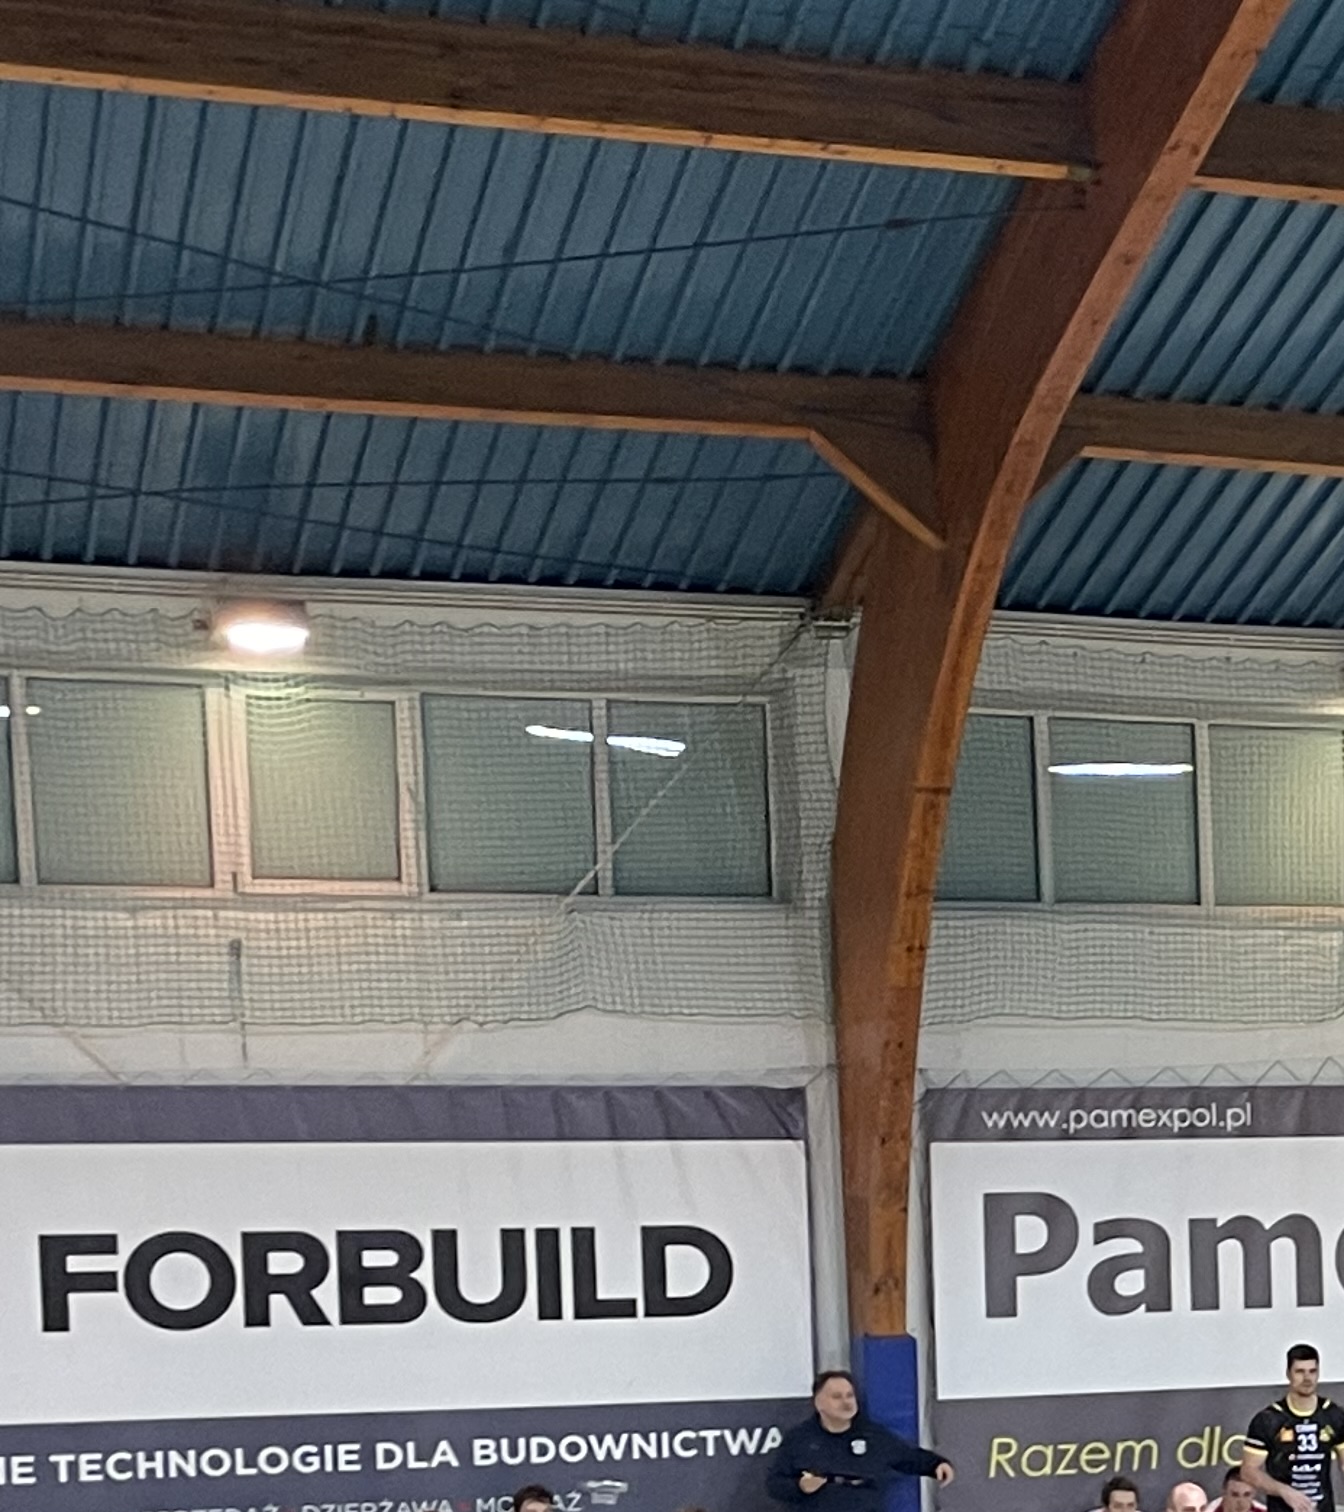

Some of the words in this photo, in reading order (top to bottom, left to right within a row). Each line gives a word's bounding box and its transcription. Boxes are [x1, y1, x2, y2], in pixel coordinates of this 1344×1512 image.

[981, 1102, 1252, 1134] www.pamexpol.pl
[38, 1224, 735, 1333] FORBUILD
[49, 1443, 362, 1484] TECHNOLOGIE
[375, 1439, 460, 1470] DLA
[472, 1426, 783, 1467] BUDOWNICTWA
[987, 1436, 1159, 1478] Razem
[1297, 1433, 1318, 1452] 33
